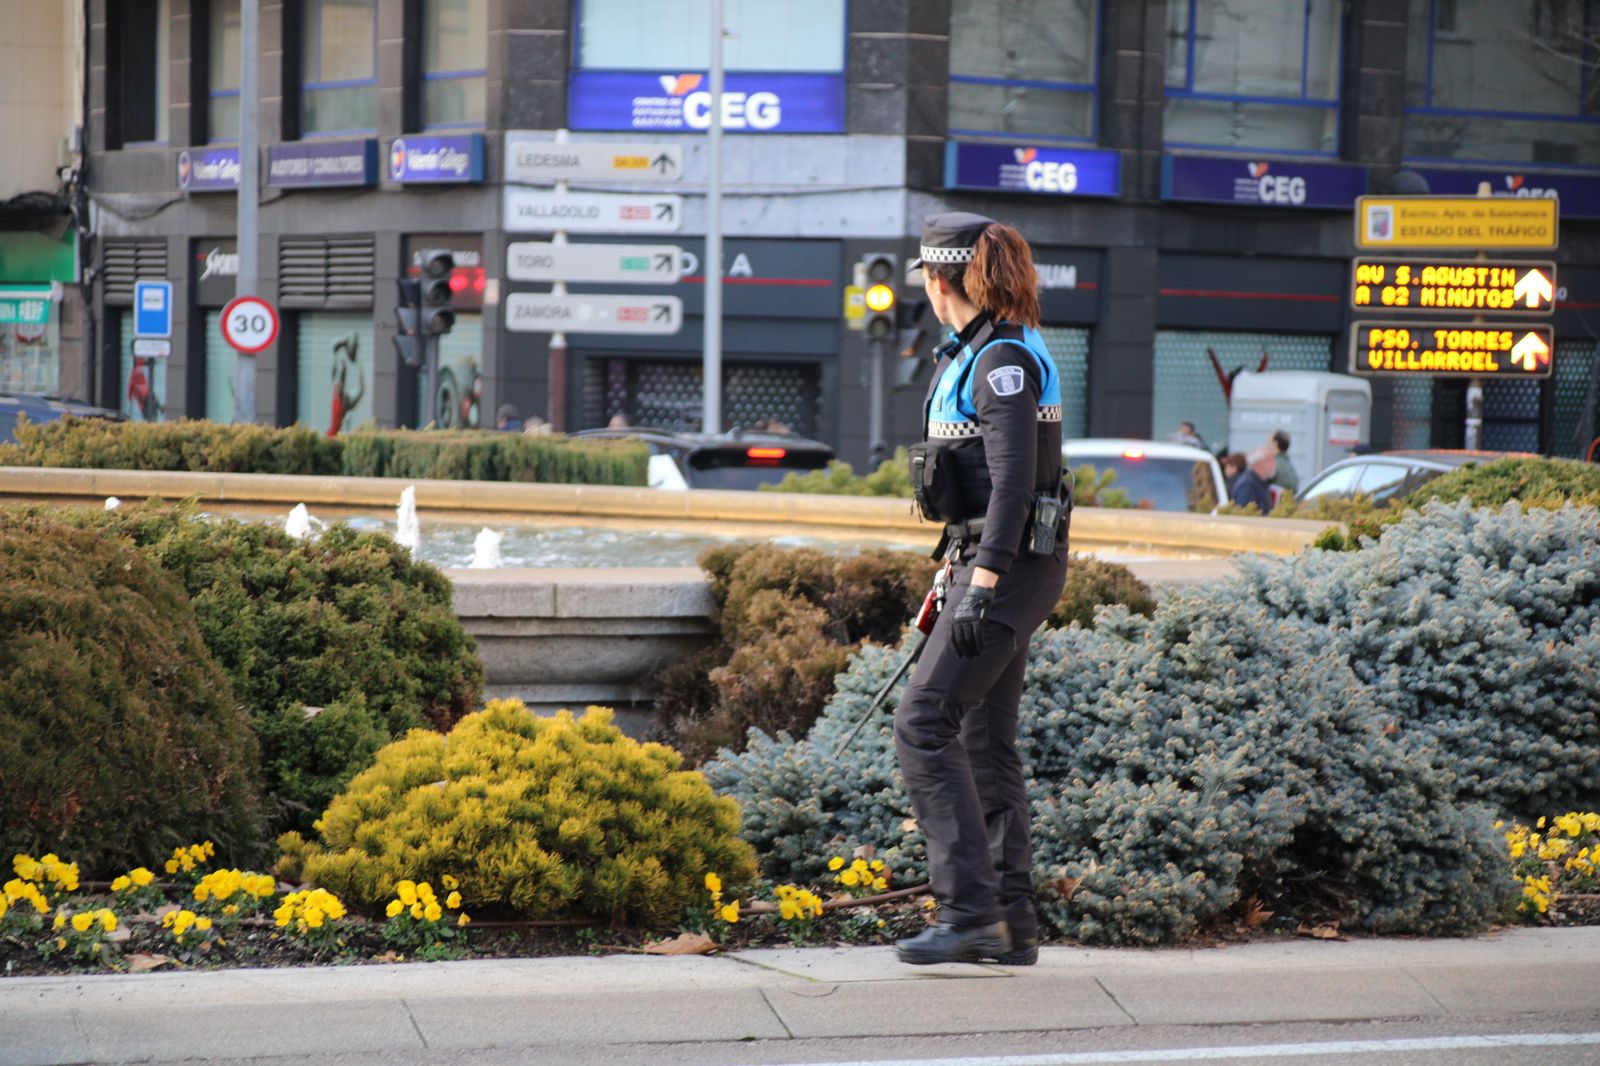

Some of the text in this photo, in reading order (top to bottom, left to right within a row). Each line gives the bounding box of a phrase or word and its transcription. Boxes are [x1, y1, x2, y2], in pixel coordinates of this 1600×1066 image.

[683, 91, 781, 129] CEG
[517, 153, 580, 167] LEDESMA
[1026, 161, 1077, 193] CEG
[1259, 175, 1306, 205] CEG
[517, 205, 599, 218] VALLADOLID
[1489, 208, 1547, 218] Salamanca
[1401, 225, 1453, 236] ESTADO
[1458, 225, 1482, 236] DEL
[516, 254, 552, 268] TORO
[1356, 265, 1516, 288] AV S.AGUSTIN
[1355, 286, 1515, 308] A 02 MINUTOS
[514, 304, 572, 319] ZAMORA
[234, 315, 265, 333] 30
[1368, 329, 1513, 350] PSO. TORRES
[1368, 350, 1498, 371] VILLARROEL
